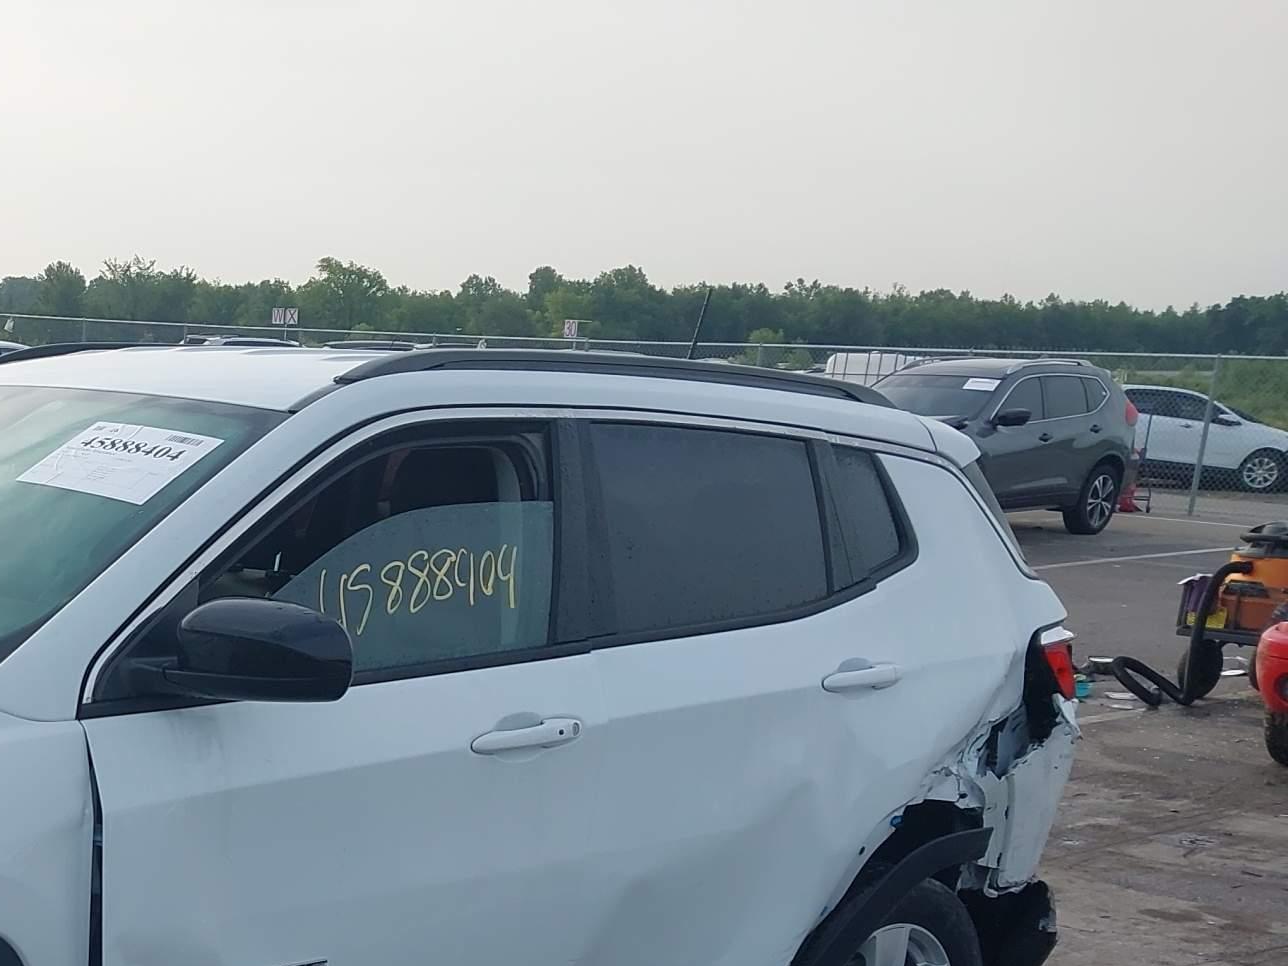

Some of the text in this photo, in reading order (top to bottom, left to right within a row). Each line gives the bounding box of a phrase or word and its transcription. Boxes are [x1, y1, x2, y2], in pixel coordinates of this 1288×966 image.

[273, 309, 284, 323] W
[287, 309, 297, 323] X
[566, 320, 577, 337] 30
[80, 436, 187, 461] 45888404
